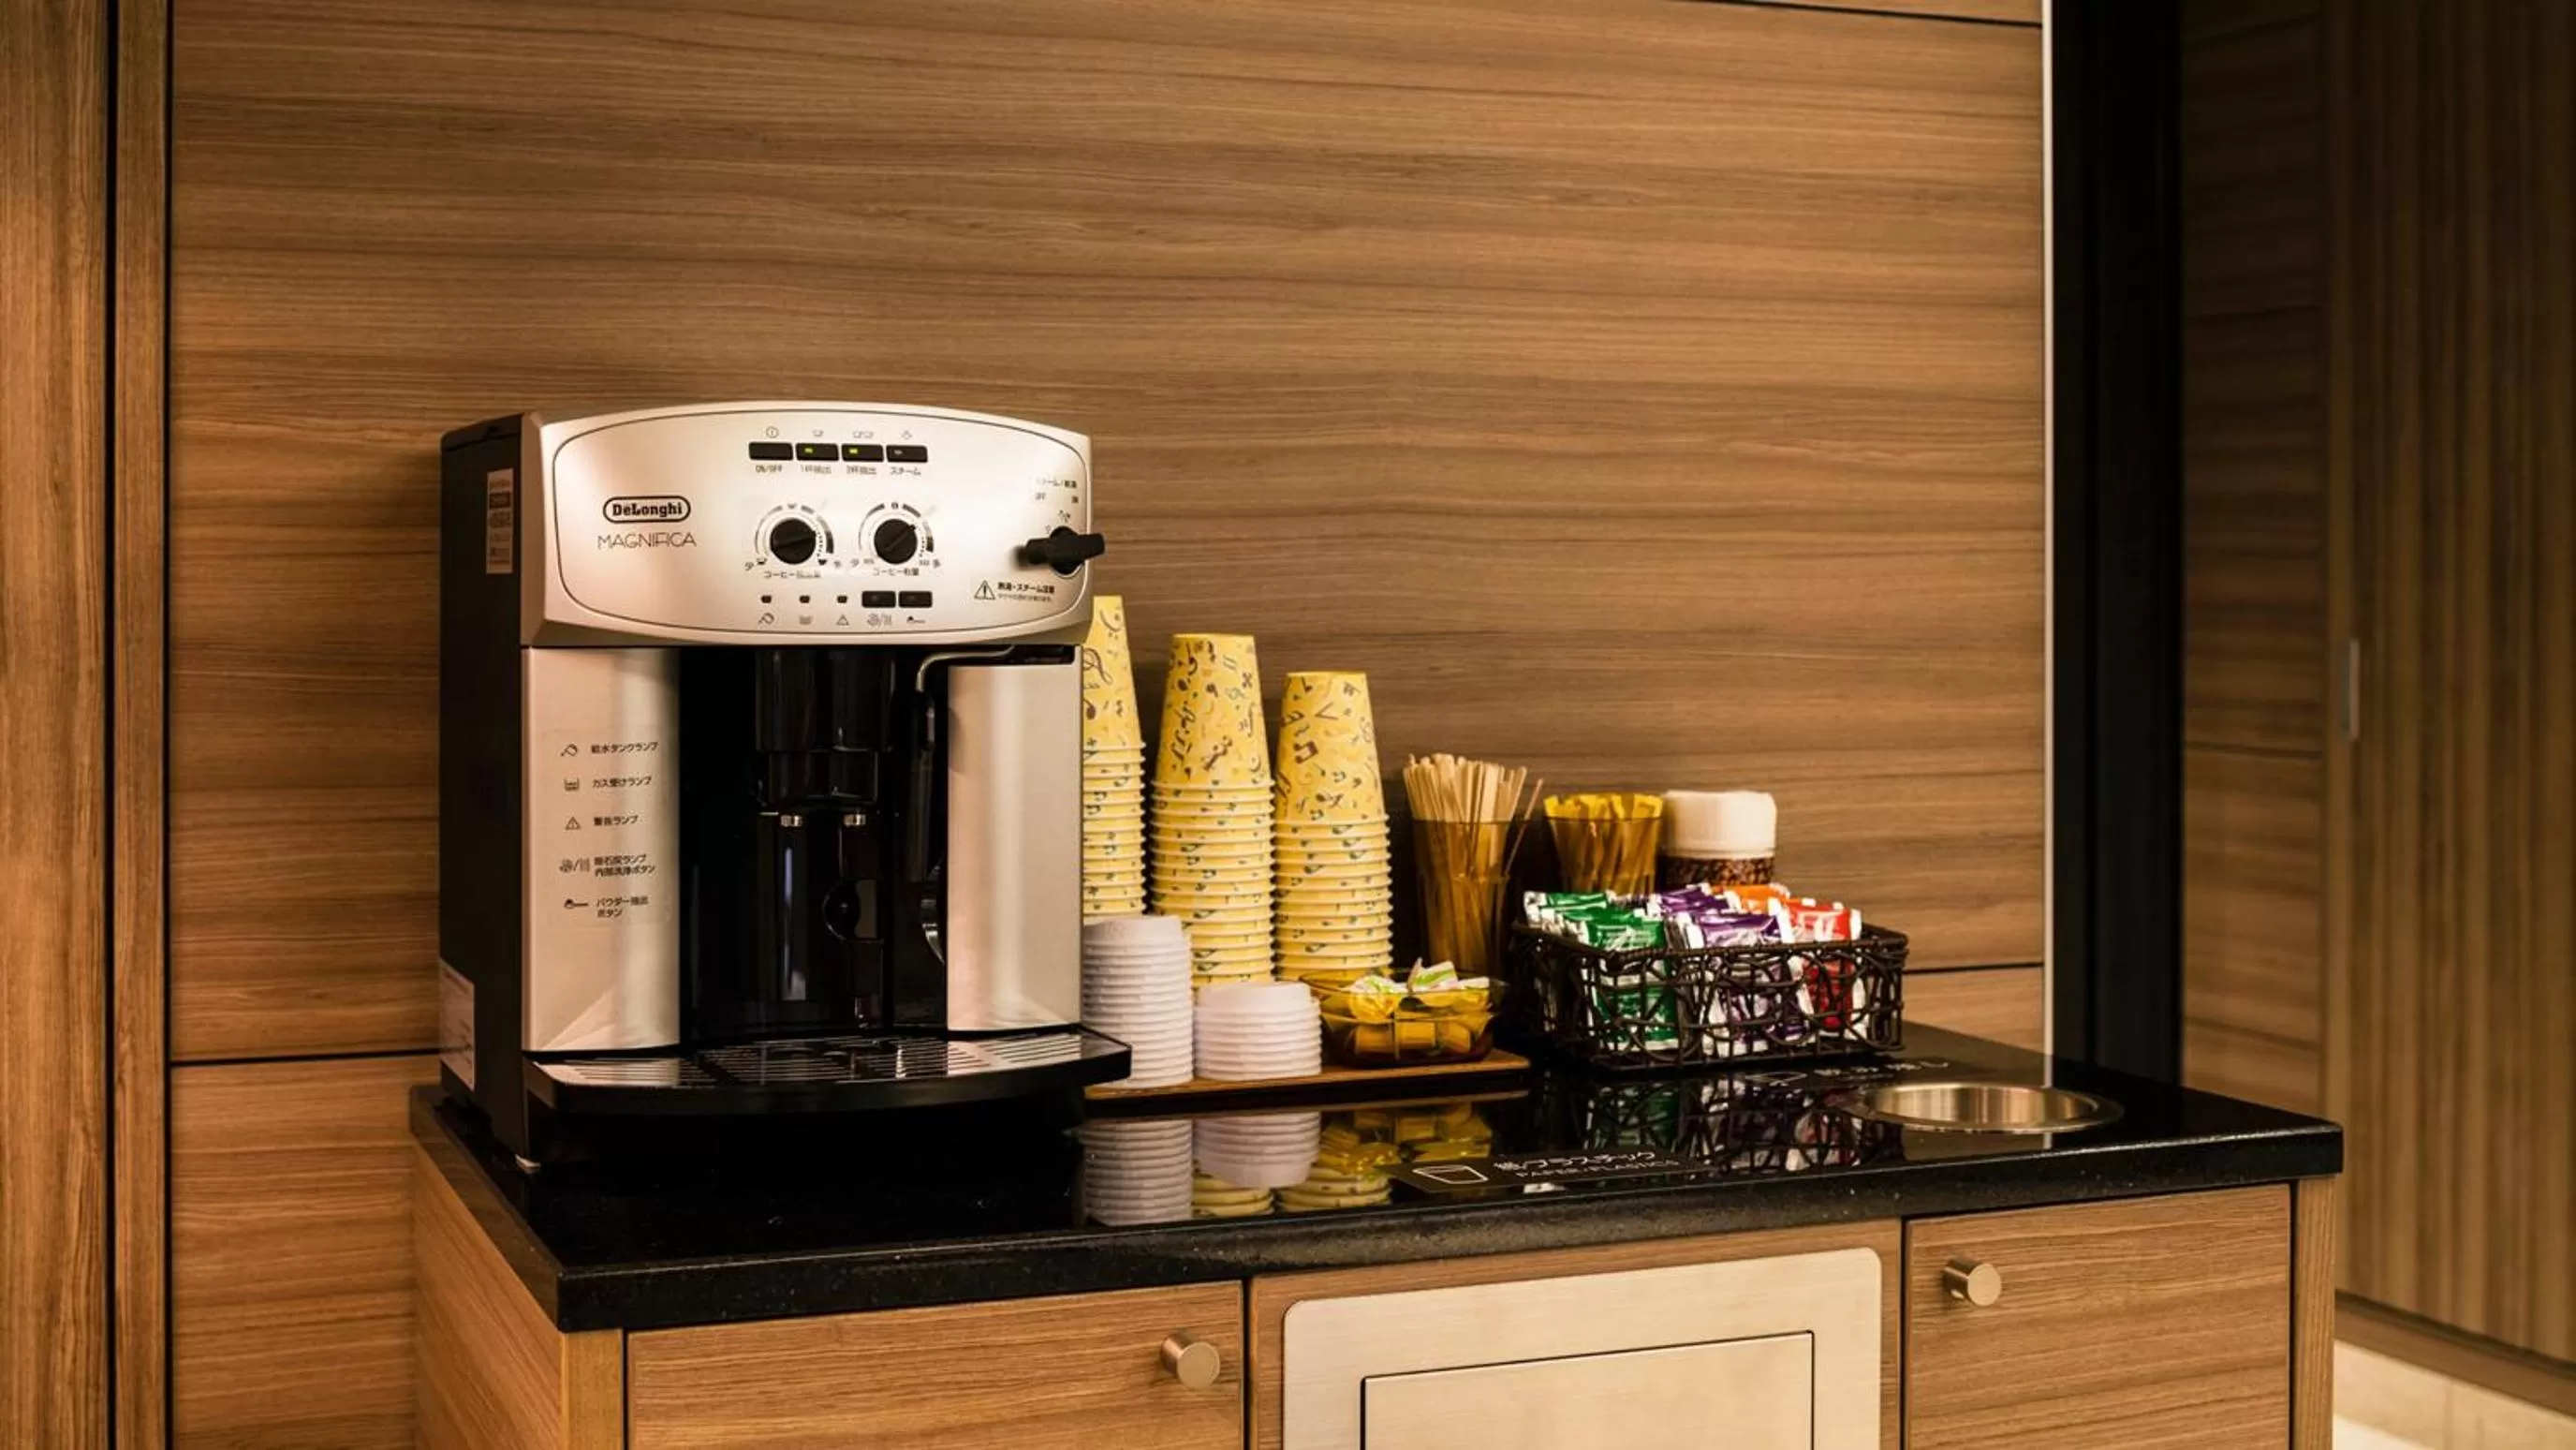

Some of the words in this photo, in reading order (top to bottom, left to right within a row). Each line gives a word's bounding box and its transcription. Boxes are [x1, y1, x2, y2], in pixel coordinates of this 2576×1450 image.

[889, 466, 921, 476] スチーム
[597, 531, 698, 549] MAGNIFICA
